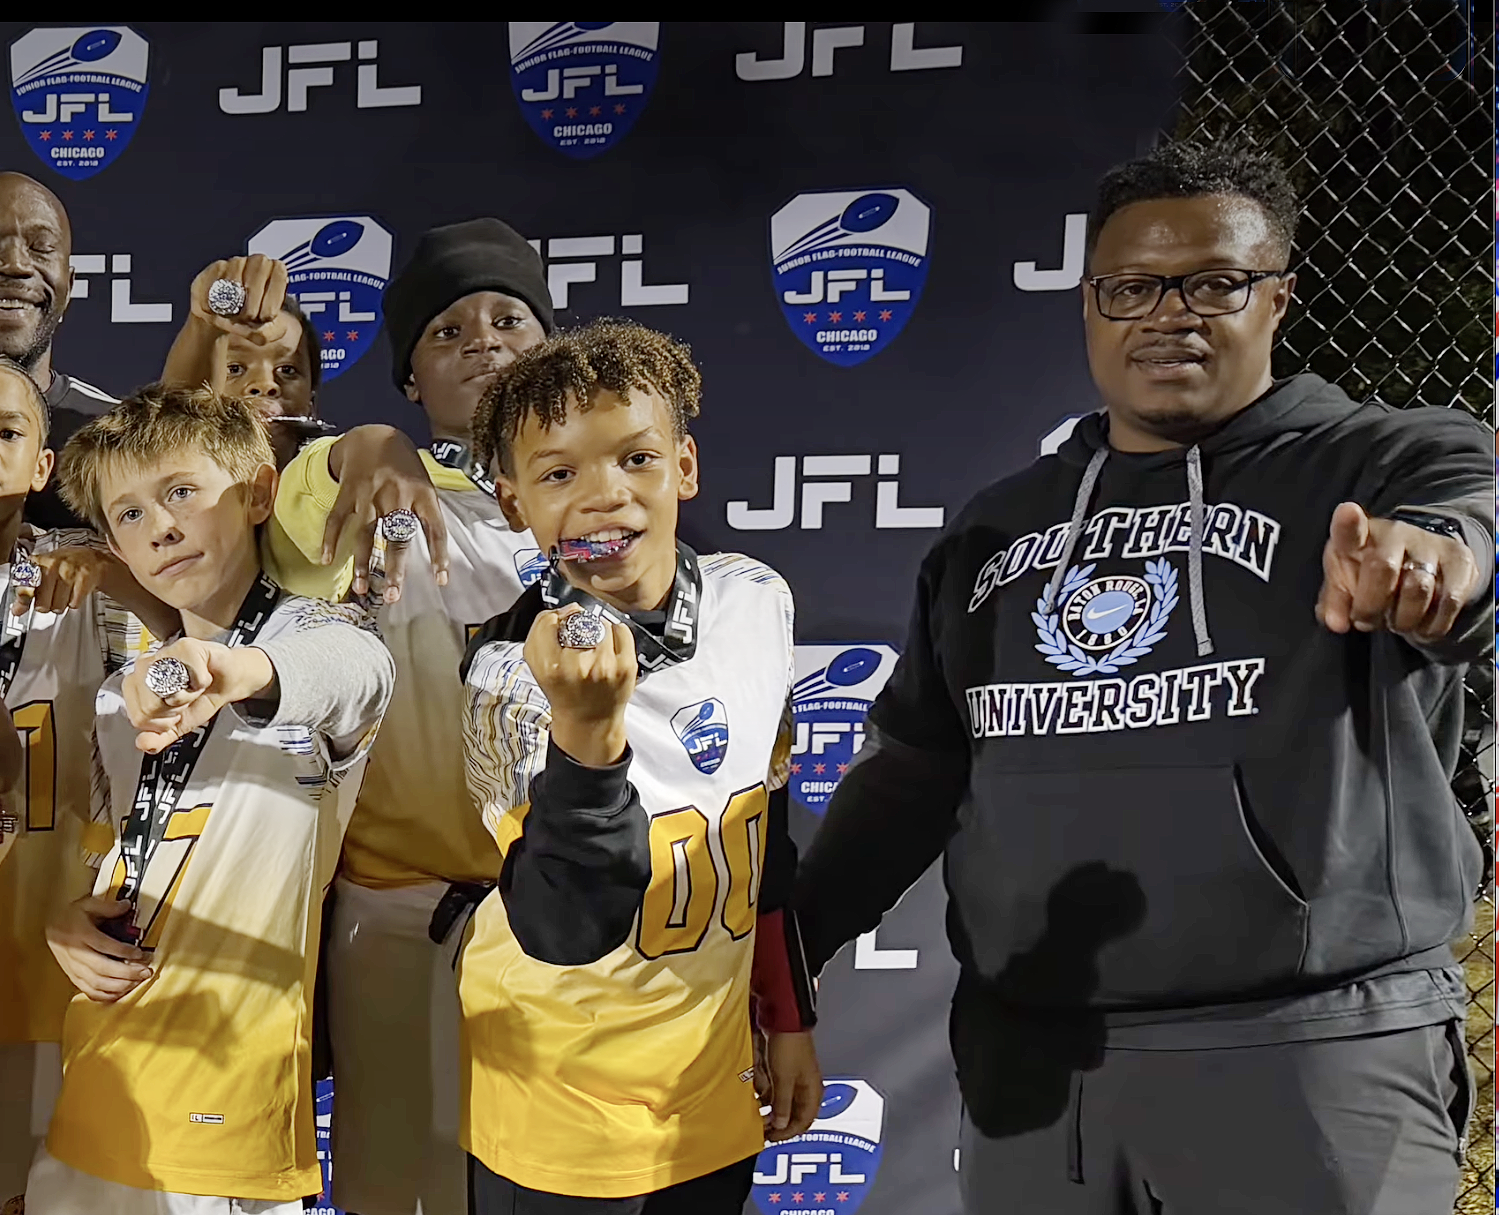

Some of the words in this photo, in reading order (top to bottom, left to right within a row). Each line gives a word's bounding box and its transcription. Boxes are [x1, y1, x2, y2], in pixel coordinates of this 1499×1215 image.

[219, 40, 421, 114] JFL
[514, 53, 547, 74] JUNIOR
[619, 45, 653, 61] LEAGUE
[16, 80, 46, 96] JUNIOR
[111, 76, 142, 93] LEAGUE
[521, 64, 644, 101] JFL
[22, 93, 133, 123] JFL
[553, 122, 613, 137] CHICAGO
[51, 147, 105, 159] CHICAGO
[528, 234, 689, 310] FL
[777, 255, 811, 275] JUNIOR
[886, 249, 921, 267] LEAGUE
[58, 254, 173, 323] FL
[353, 273, 385, 291] LEAGUE
[784, 268, 910, 304] JFL
[287, 291, 375, 322] FL
[816, 329, 877, 343] CHICAGO
[822, 344, 844, 352] EST.
[727, 453, 944, 530] JFL
[968, 501, 1281, 613] SOUTHERN
[671, 582, 696, 644] JFL
[1068, 584, 1101, 621] BATON
[227, 612, 263, 648] FL
[1076, 626, 1127, 646] 1880
[966, 658, 1265, 738] UNIVERSITY
[689, 732, 728, 754] JFL
[135, 760, 157, 821] JFL
[157, 763, 190, 825] JFL
[124, 835, 143, 898] JFL
[635, 781, 768, 961] 00
[844, 1136, 876, 1153] LEAGUE
[753, 1153, 865, 1184] JFL
